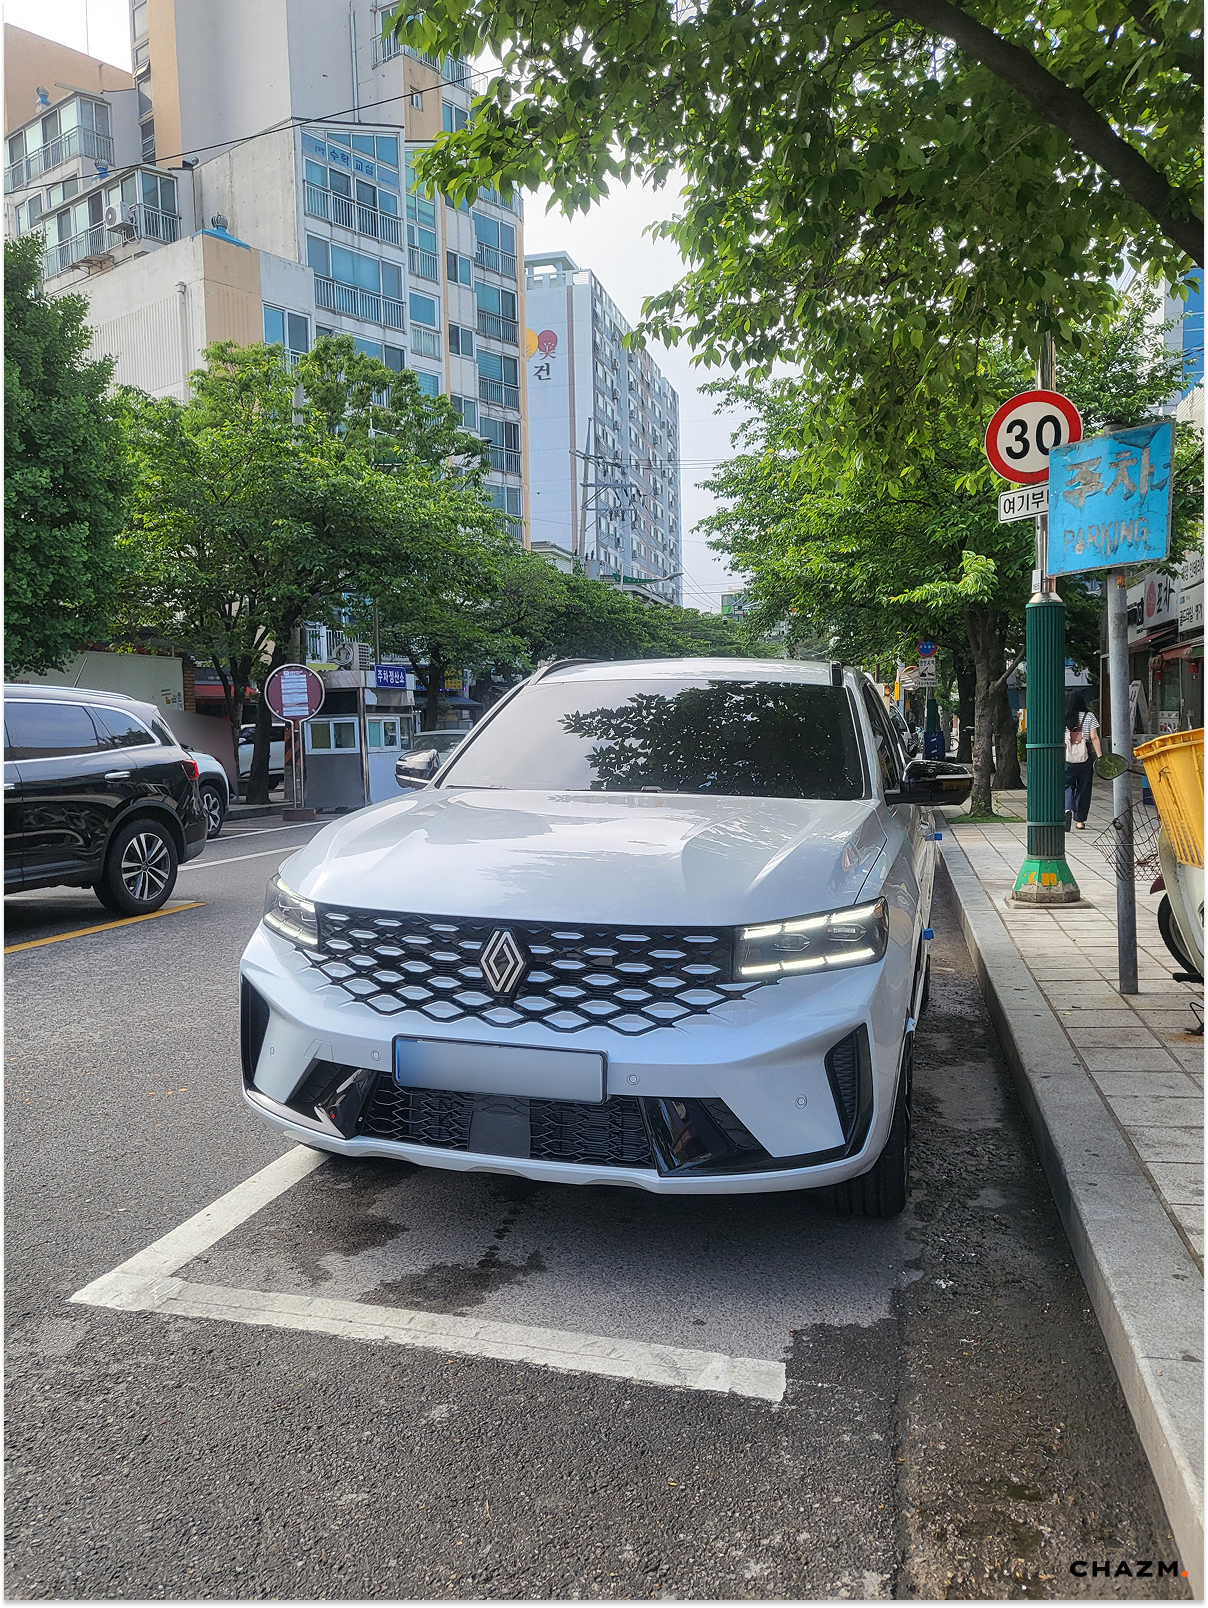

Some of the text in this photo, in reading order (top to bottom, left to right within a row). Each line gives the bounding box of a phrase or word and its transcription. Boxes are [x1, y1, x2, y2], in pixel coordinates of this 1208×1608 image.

[330, 150, 349, 166] 수학
[355, 159, 373, 176] 교실
[533, 363, 551, 380] 건
[1005, 415, 1062, 459] 30
[1063, 447, 1155, 506] 주차
[1003, 489, 1049, 514] 여기부
[1063, 517, 1148, 555] PARKING
[377, 669, 405, 684] 주차정산소
